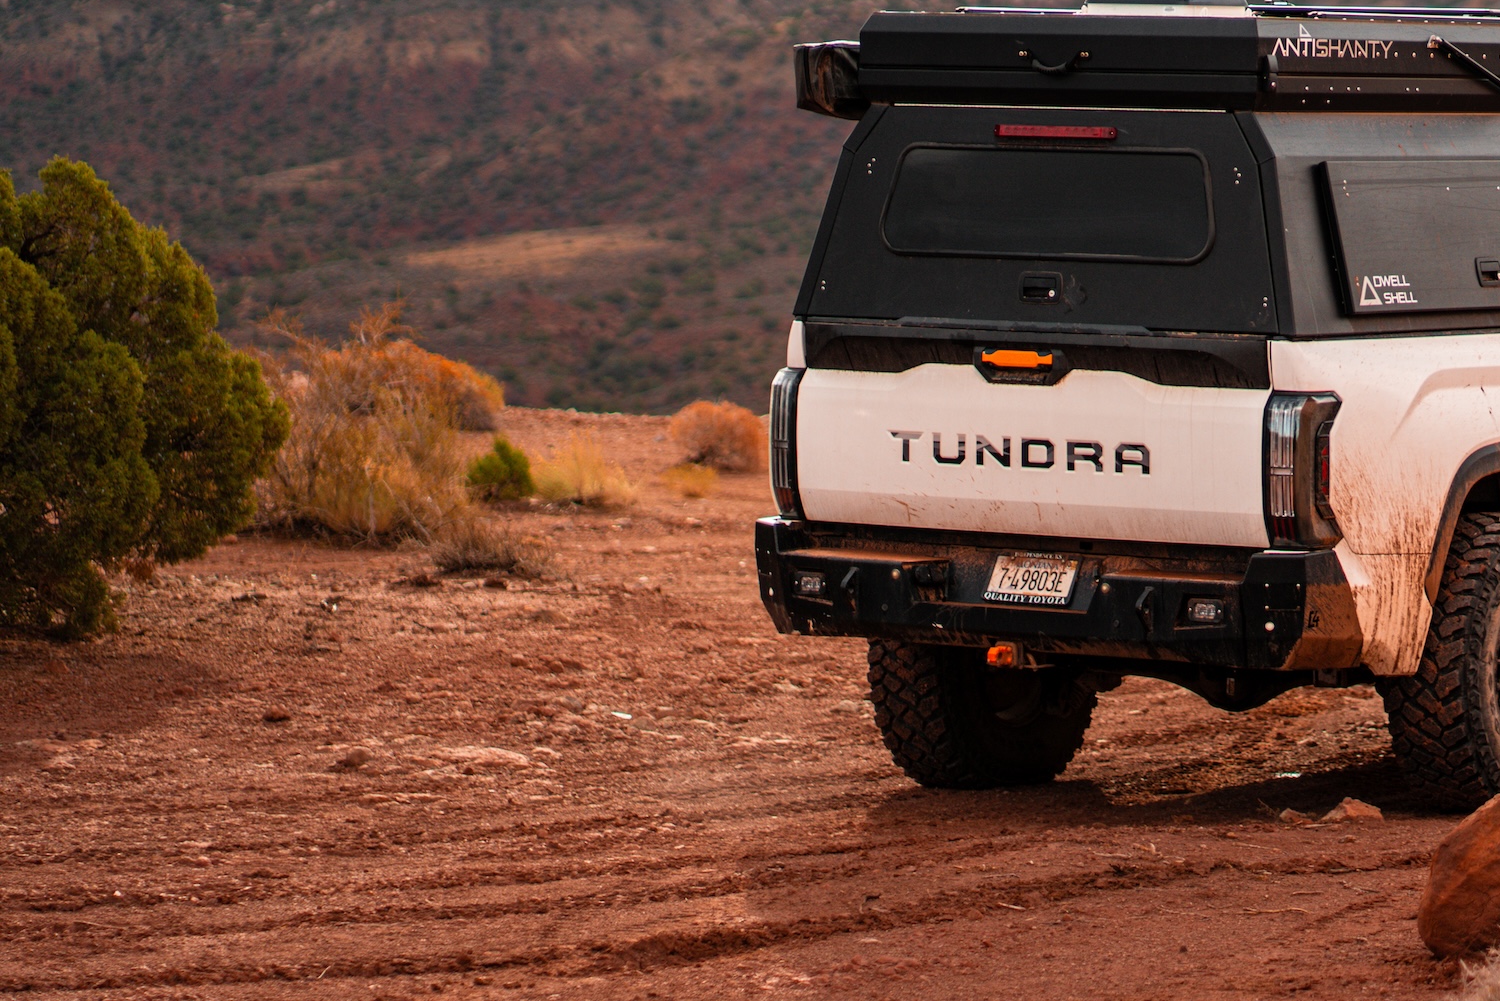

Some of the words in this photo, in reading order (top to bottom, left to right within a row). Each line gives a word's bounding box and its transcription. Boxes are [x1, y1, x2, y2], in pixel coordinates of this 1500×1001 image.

[1271, 37, 1393, 59] ANTISHANTY
[1373, 275, 1410, 287] DWELL
[1383, 292, 1418, 304] SHELL
[887, 430, 1151, 476] TUNDRA
[984, 591, 1027, 603] QUALITY
[1028, 595, 1066, 605] TOYOTA
